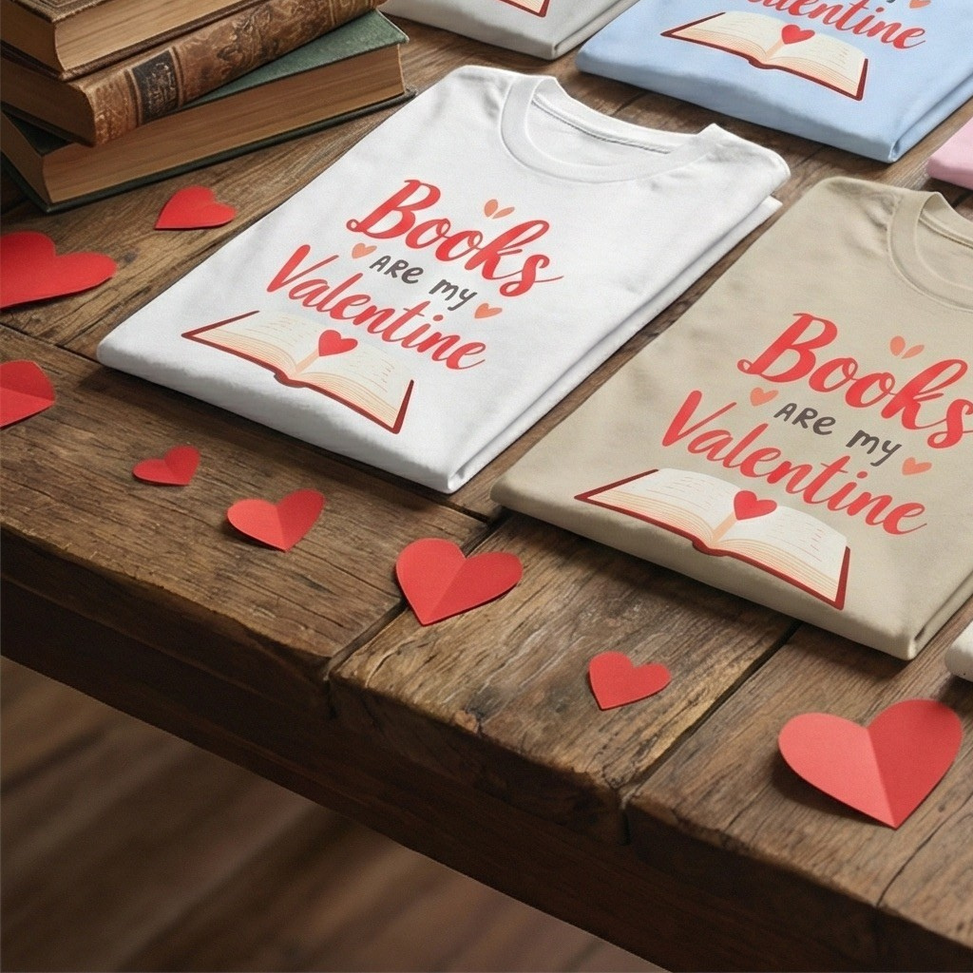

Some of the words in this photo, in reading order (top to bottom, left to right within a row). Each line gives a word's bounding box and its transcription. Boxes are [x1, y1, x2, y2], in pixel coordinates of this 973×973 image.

[346, 179, 564, 297] Books
[428, 278, 478, 311] my
[266, 244, 486, 370] Valentine
[661, 389, 928, 535] Valentine
[846, 429, 903, 467] my
